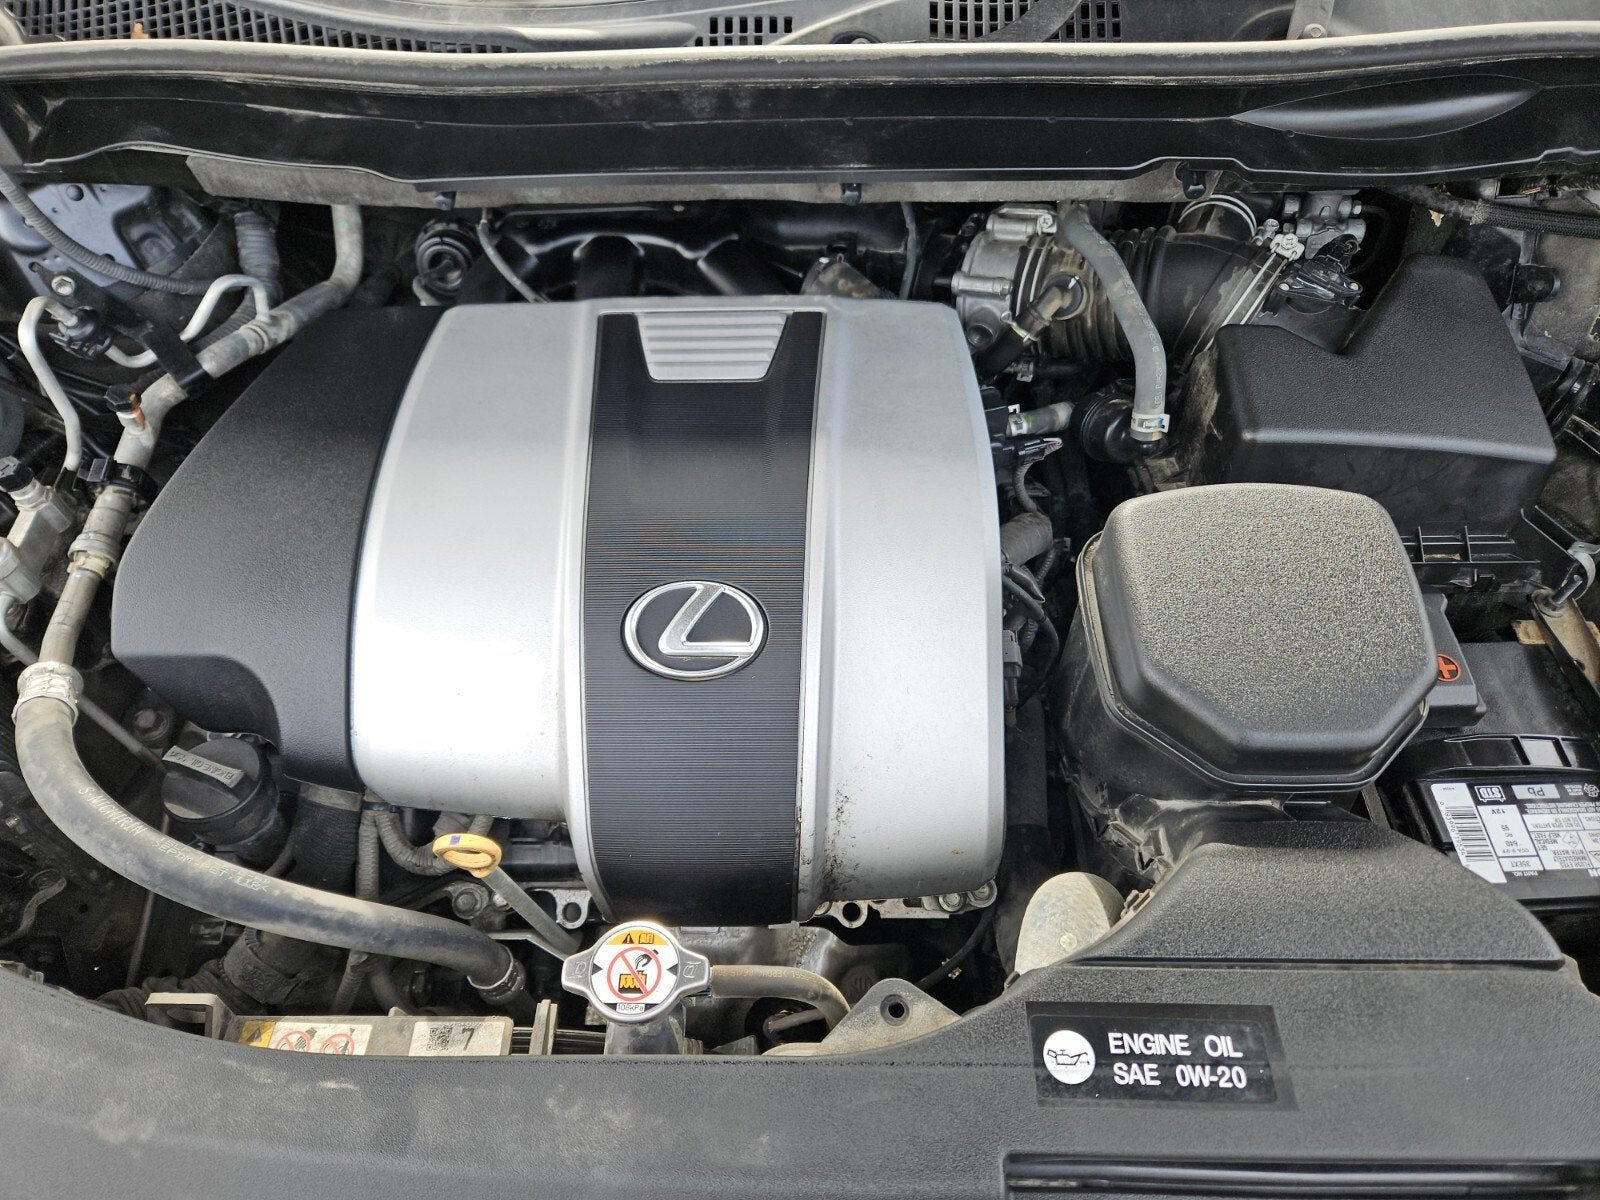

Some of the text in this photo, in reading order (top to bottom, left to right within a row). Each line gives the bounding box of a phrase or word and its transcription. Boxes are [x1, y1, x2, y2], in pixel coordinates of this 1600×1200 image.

[1527, 787, 1546, 797] Pb
[461, 1027, 475, 1051] 7
[1107, 1032, 1243, 1058] ENGINE OIL
[1113, 1062, 1247, 1089] SAE 0W-20
